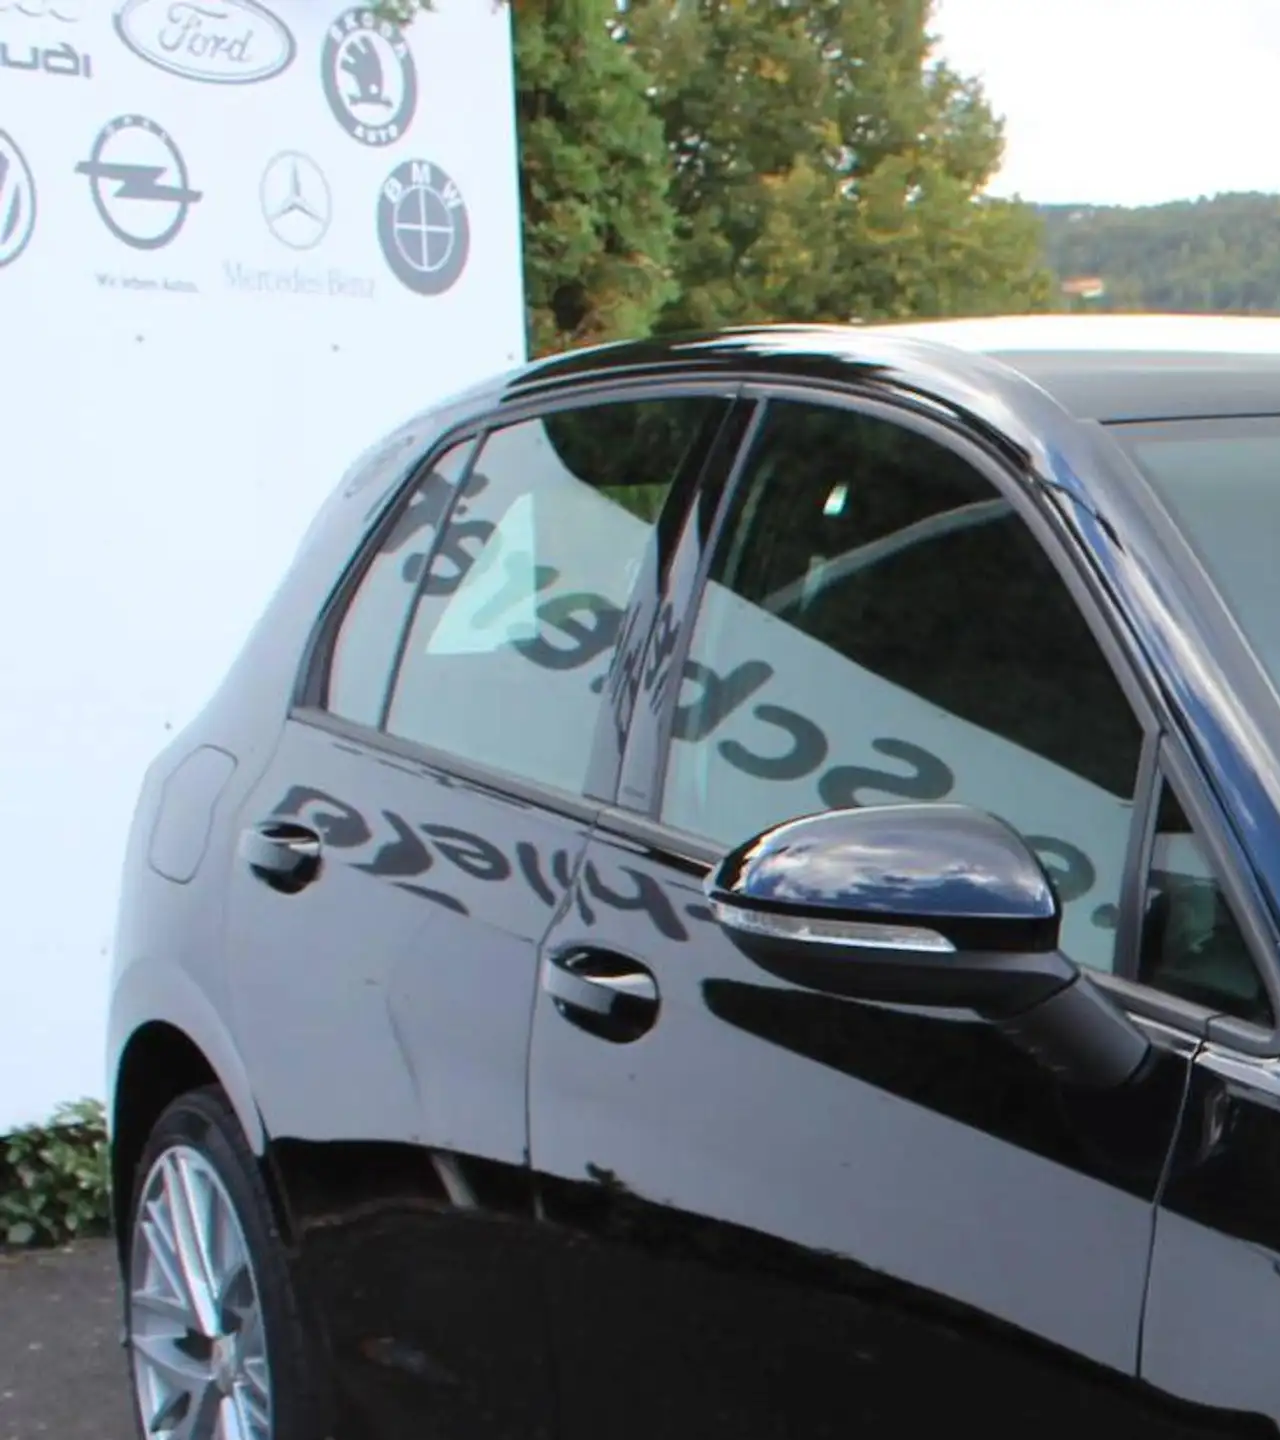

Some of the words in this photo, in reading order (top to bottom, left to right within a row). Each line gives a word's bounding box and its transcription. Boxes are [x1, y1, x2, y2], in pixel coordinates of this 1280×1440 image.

[158, 2, 254, 63] Ford
[0, 41, 93, 79] udi
[384, 163, 461, 208] BMW
